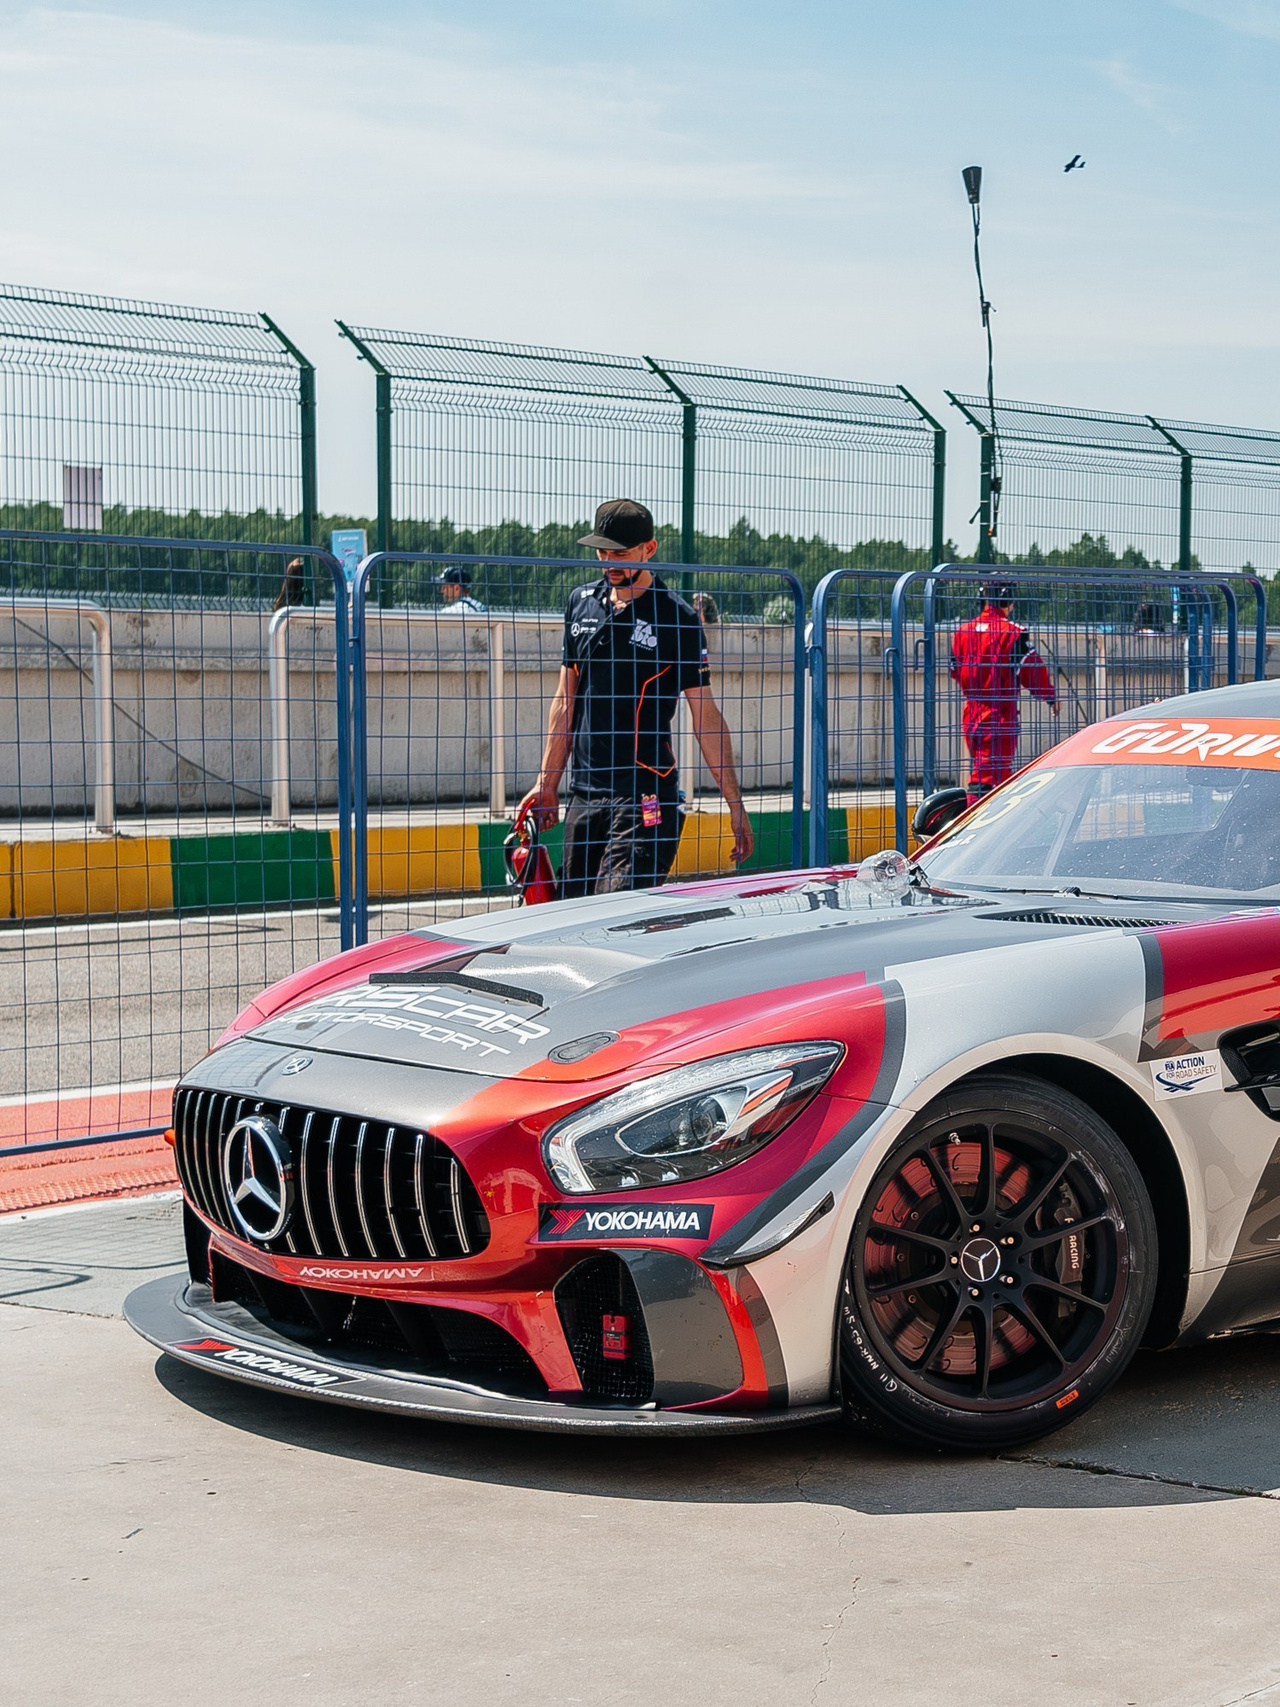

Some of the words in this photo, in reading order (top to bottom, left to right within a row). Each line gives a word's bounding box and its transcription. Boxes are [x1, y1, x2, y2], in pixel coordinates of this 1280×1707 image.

[277, 1012, 511, 1057] MOTORSPORT
[1176, 1056, 1205, 1070] ACTION
[1176, 1069, 1193, 1079] ROAD
[1193, 1064, 1217, 1076] SAFETY
[585, 1210, 700, 1232] YOKOHAMA
[1068, 1235, 1080, 1269] RACING
[214, 1348, 340, 1386] YOKOHAMA
